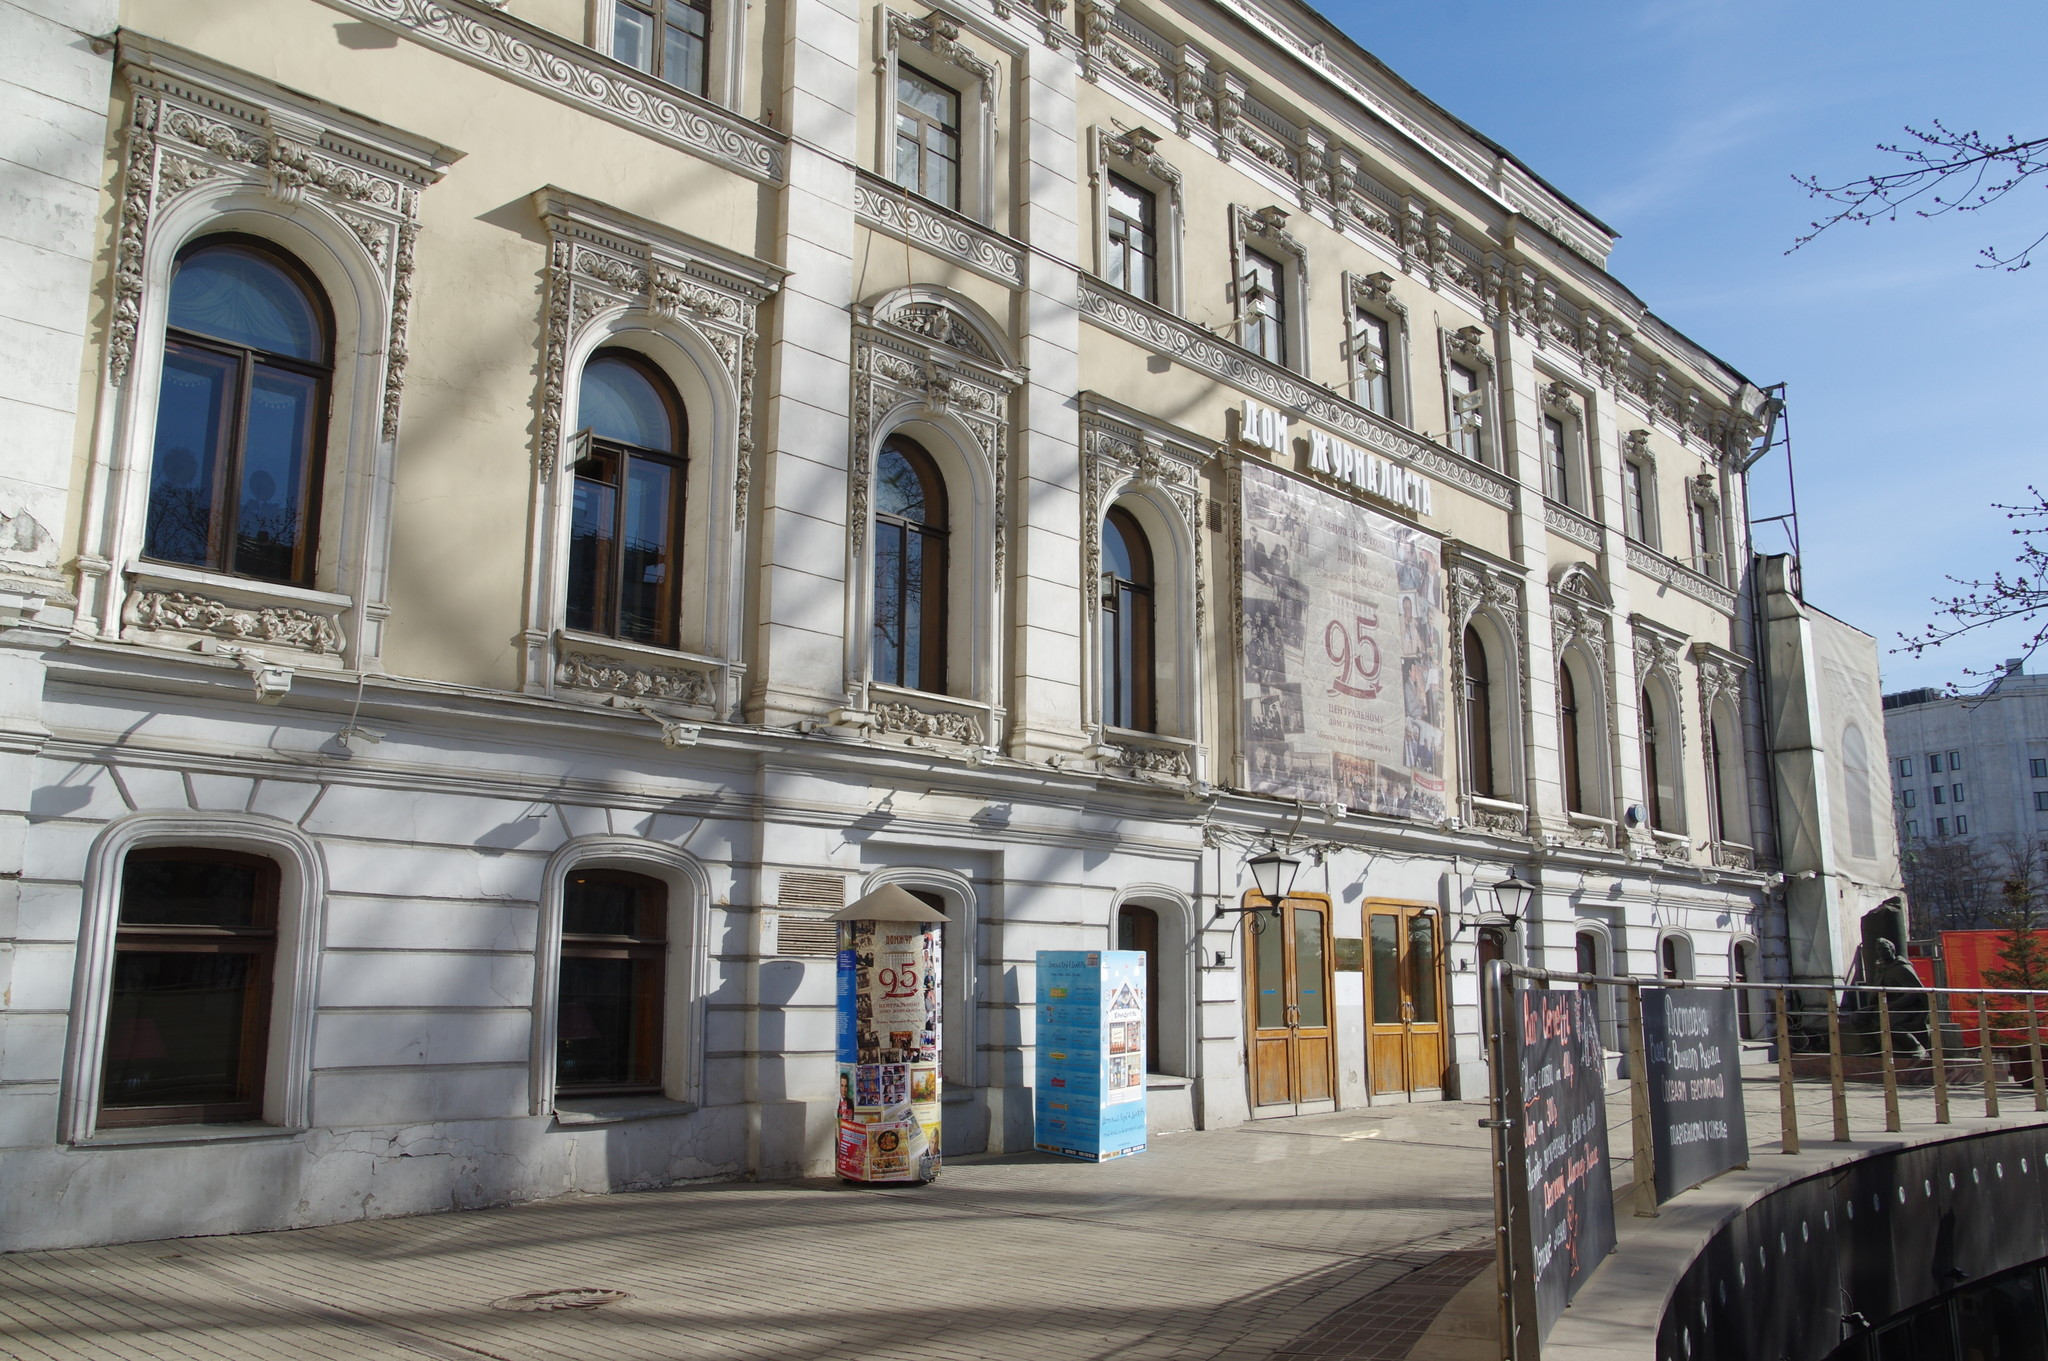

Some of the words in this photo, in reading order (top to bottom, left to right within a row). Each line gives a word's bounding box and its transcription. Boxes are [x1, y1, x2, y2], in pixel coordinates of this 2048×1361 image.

[1240, 400, 1288, 455] ДОМ
[1307, 429, 1433, 517] ЖУРНАЛИСТА
[1325, 614, 1382, 684] 95
[1328, 703, 1384, 724] ЦЕНТРАЛЬНОМУ
[885, 935, 913, 945] ДОМЖУР
[879, 960, 918, 993] 95
[1664, 993, 1709, 1037] Доставка
